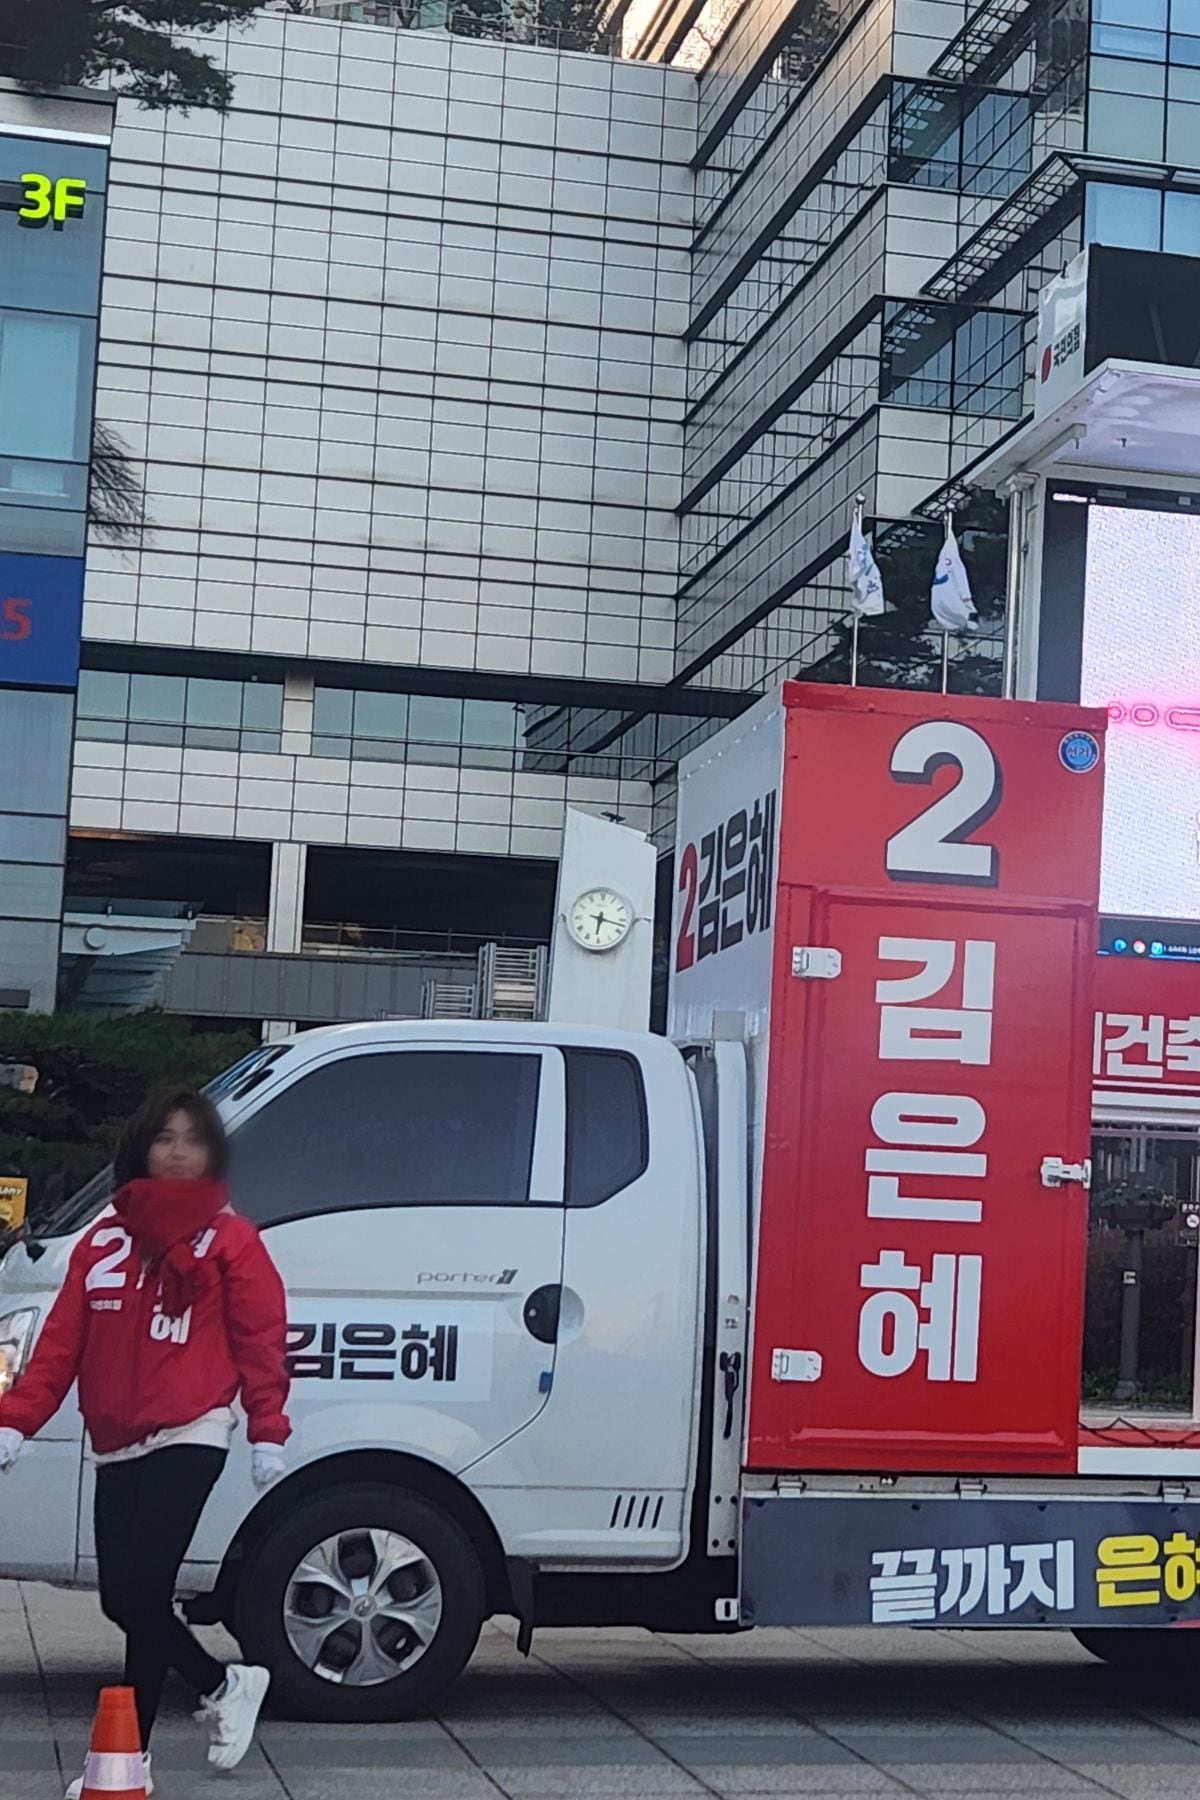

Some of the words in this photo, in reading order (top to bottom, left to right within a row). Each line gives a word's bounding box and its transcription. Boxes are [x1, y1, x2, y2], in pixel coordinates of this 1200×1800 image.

[19, 173, 86, 220] 3F
[885, 720, 999, 884] 2
[697, 788, 777, 962] 김은혜
[857, 936, 997, 1382] 김은혜
[85, 1226, 133, 1292] 2
[285, 1322, 459, 1382] 김은혜
[869, 1539, 1075, 1623] 끝까지
